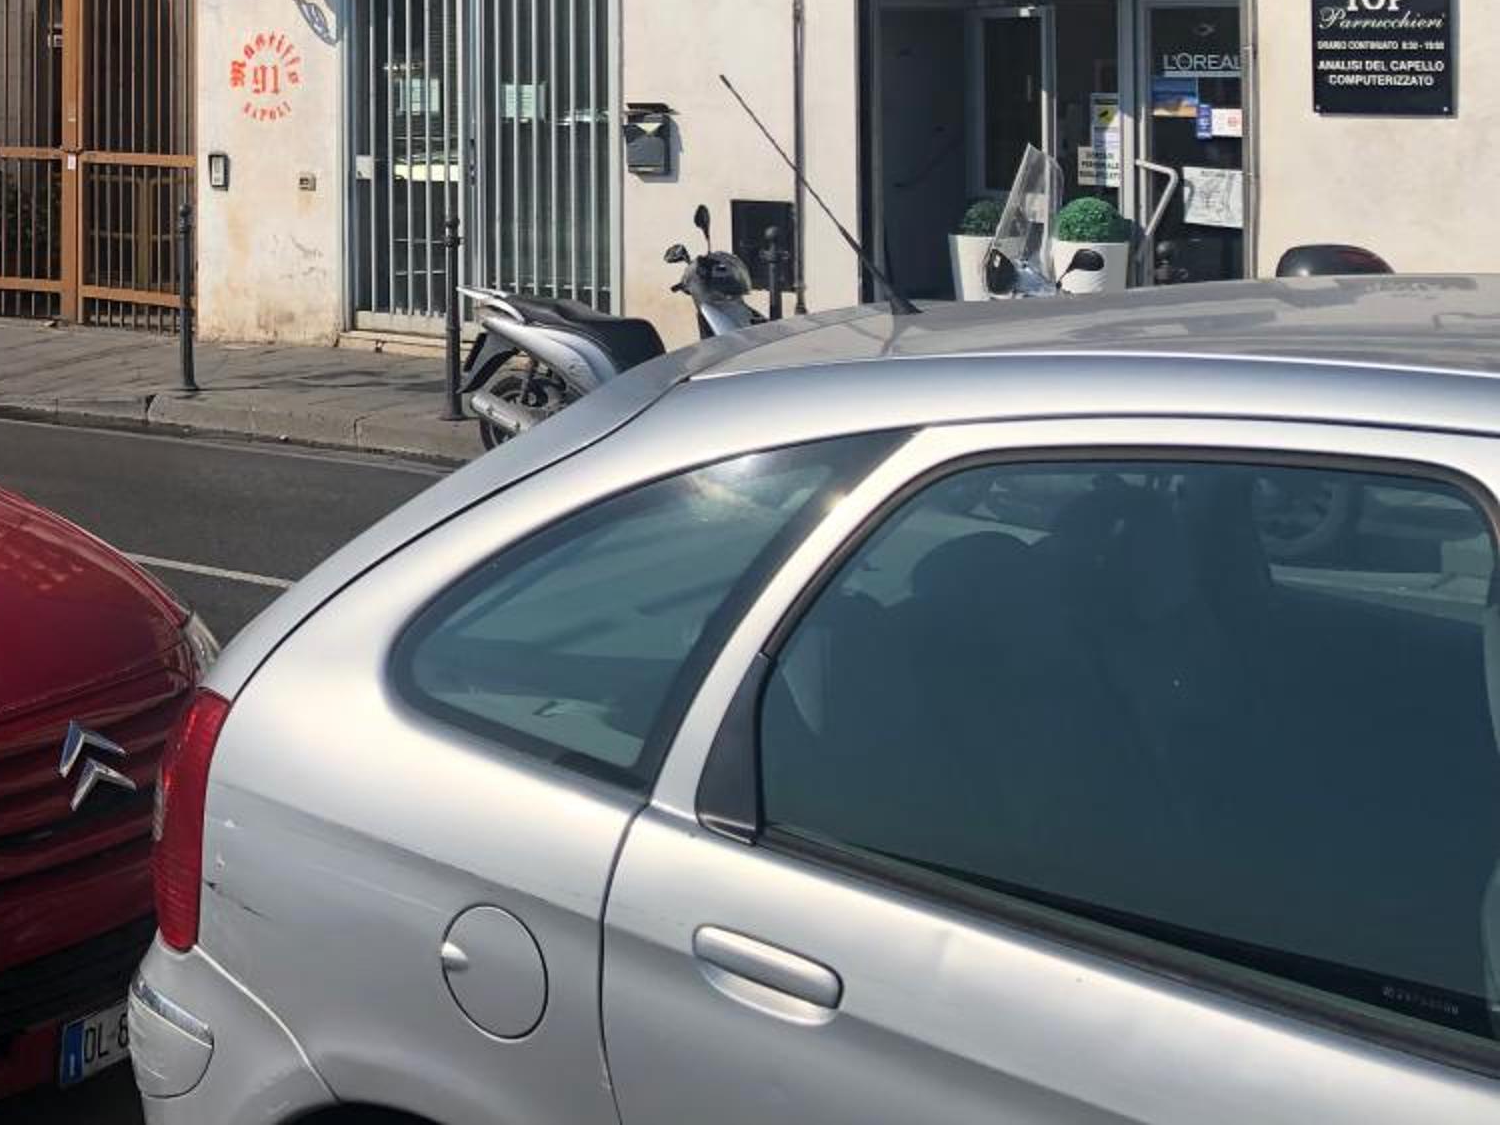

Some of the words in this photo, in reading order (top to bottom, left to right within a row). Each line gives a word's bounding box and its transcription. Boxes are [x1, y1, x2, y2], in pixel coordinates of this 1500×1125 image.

[1319, 6, 1445, 29] Parrucchieri
[1317, 60, 1363, 71] ANALISI
[1365, 60, 1388, 72] DEL
[1390, 60, 1445, 72] CAPELLO
[252, 64, 280, 94] 91
[1328, 74, 1435, 86] COMPUTERIZZATO
